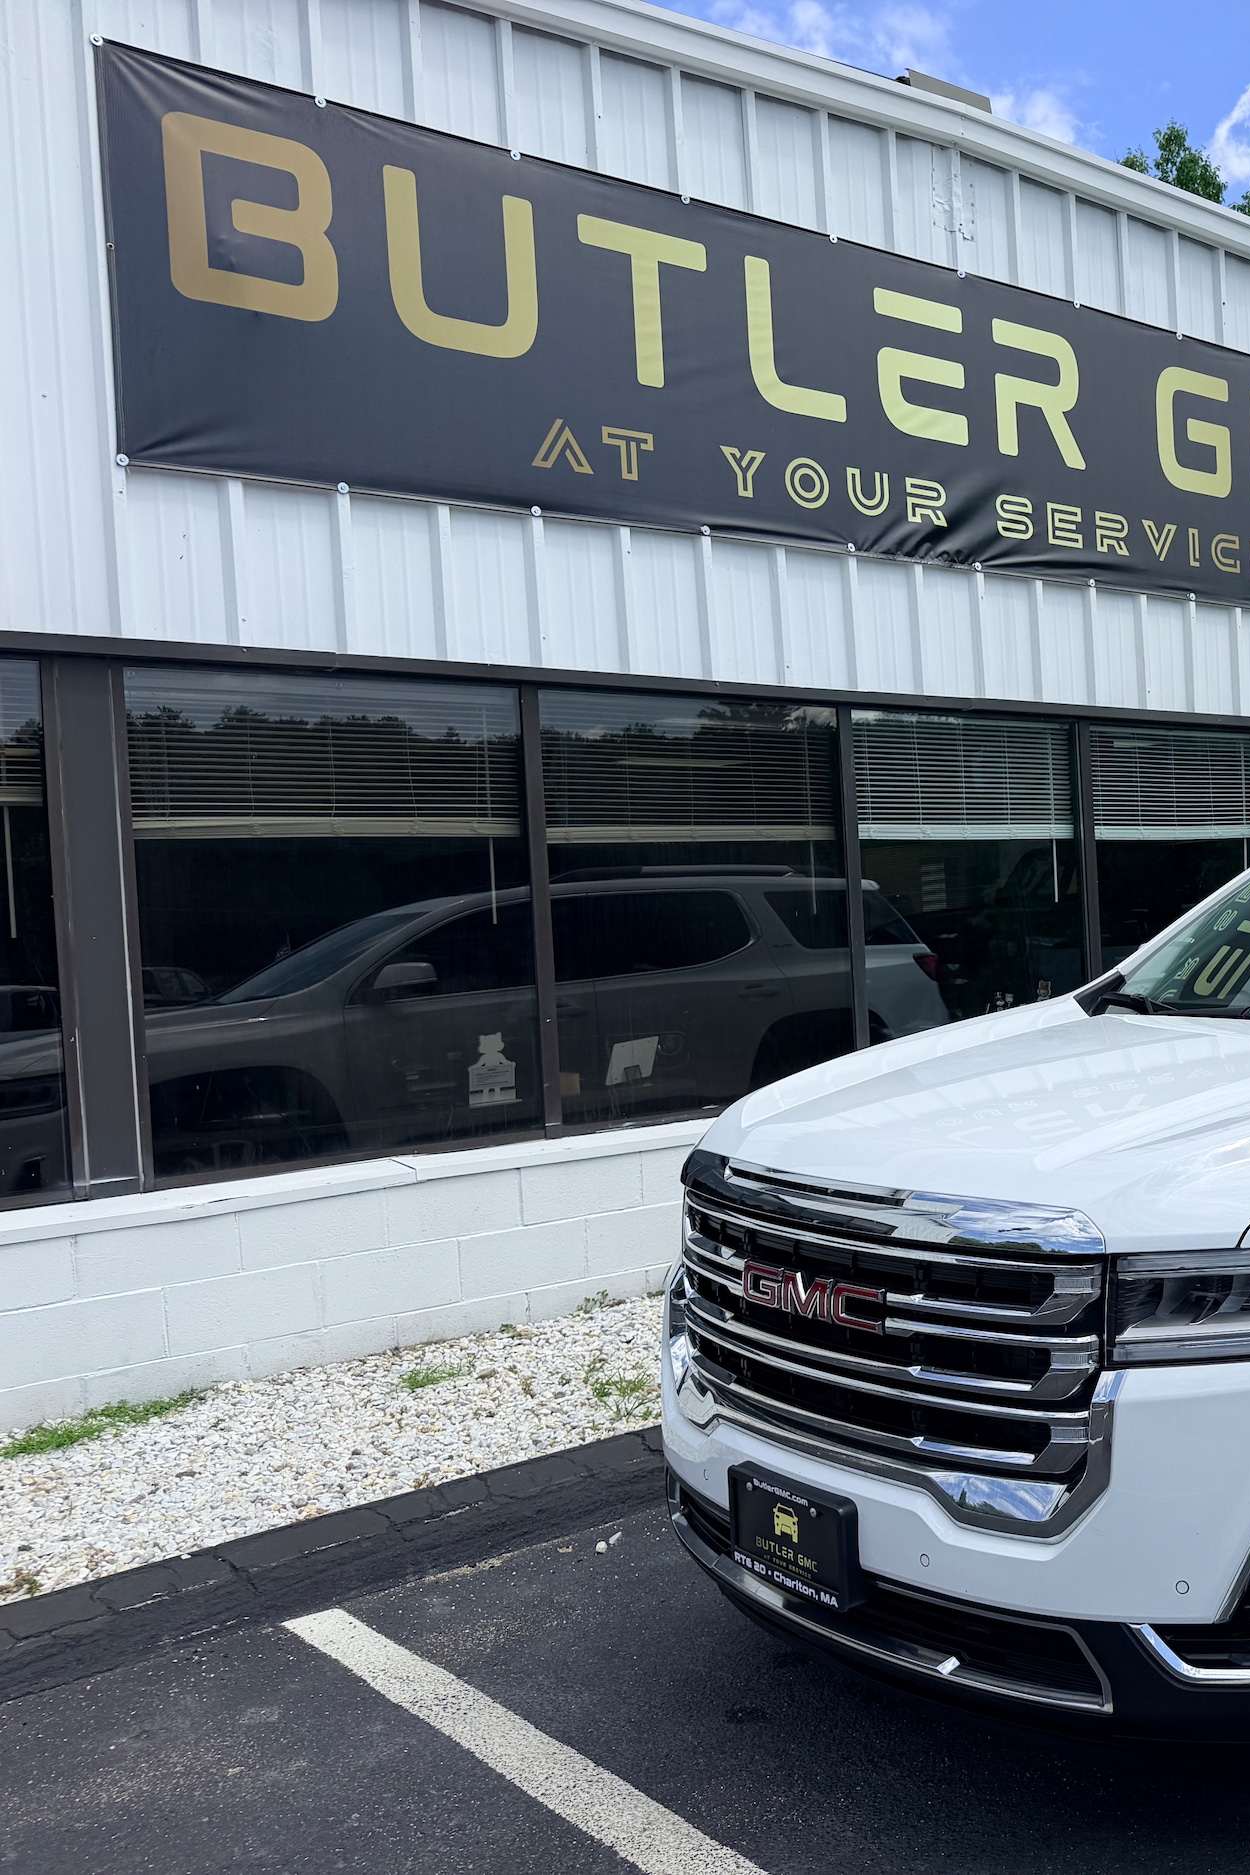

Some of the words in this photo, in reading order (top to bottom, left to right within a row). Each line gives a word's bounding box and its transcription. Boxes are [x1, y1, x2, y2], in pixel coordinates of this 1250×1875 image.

[161, 111, 1087, 472] BUTLER
[531, 418, 655, 482] AT
[719, 444, 949, 528] YOUR
[742, 1259, 885, 1336] GMC
[753, 1478, 808, 1506] ButlerGMC.com
[753, 1560, 766, 1574] 20
[773, 1570, 819, 1601] Charlton,
[820, 1592, 838, 1608] MA
[756, 1536, 794, 1561] BUTLER
[797, 1553, 818, 1573] GMC
